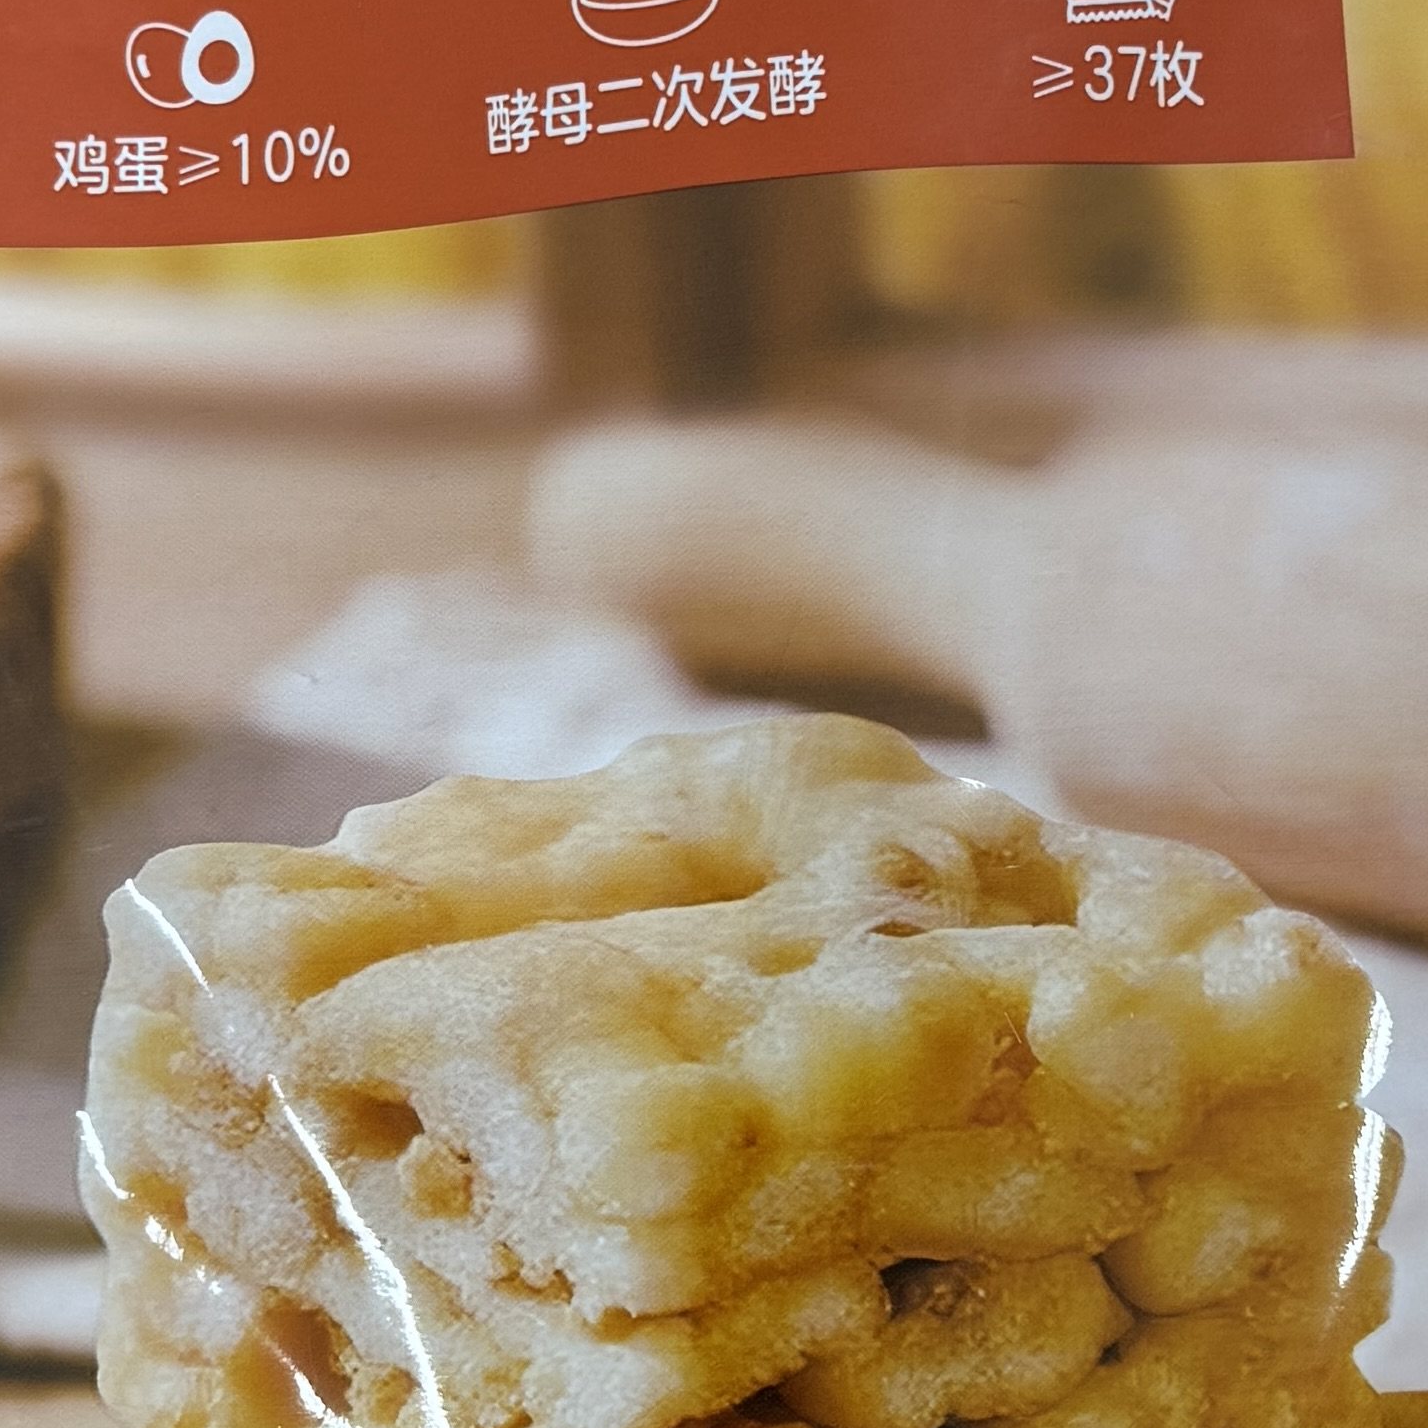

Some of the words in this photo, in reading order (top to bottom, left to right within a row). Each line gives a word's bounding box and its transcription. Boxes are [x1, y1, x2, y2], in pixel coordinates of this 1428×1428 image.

[484, 48, 828, 156] 酵母二次发酵
